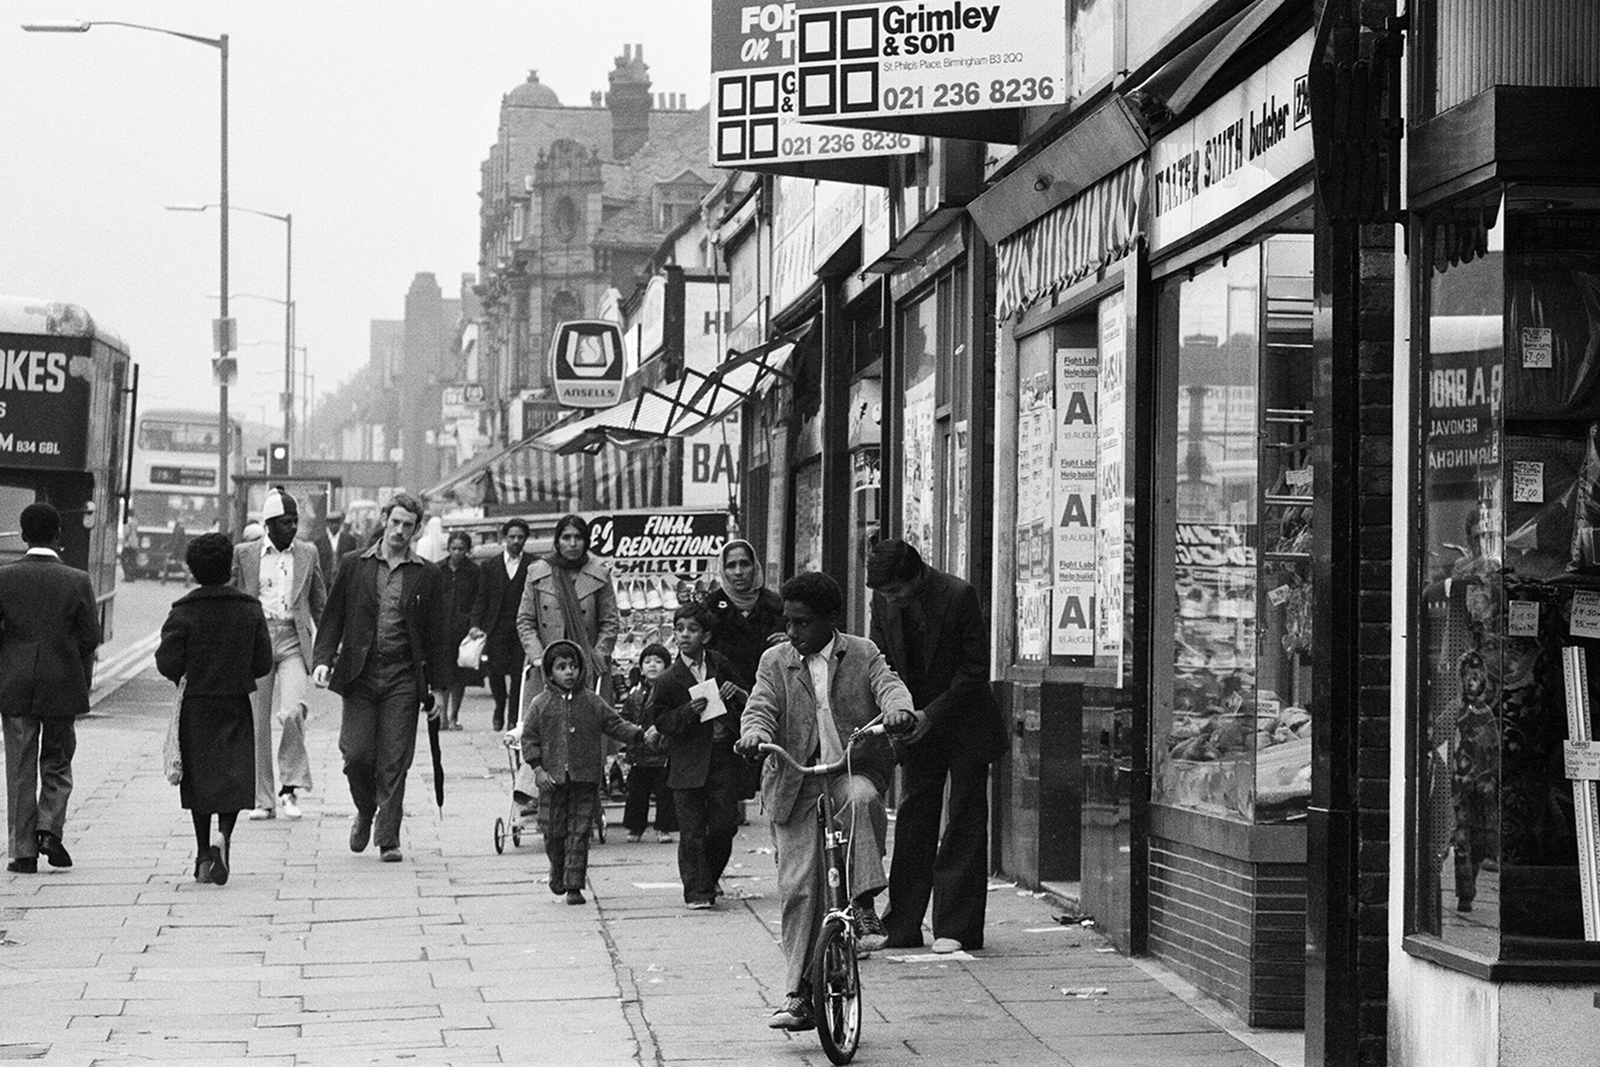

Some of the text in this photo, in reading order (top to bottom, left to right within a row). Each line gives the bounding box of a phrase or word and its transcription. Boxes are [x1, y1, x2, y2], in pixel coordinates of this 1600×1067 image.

[883, 1, 1000, 34] Grimley
[883, 32, 954, 57] & son
[944, 54, 987, 68] Birmingham
[989, 54, 1001, 64] B3
[781, 71, 796, 95] G
[883, 76, 1054, 111] 021 236 8236
[781, 97, 794, 113] &
[782, 132, 911, 156] 021 236 8236
[1204, 118, 1244, 188] SMITH
[1249, 95, 1290, 161] butcher
[1064, 357, 1097, 366] Fight Lab
[1064, 368, 1079, 376] Help
[1064, 382, 1086, 391] VOTE
[16, 440, 36, 453] B34
[692, 443, 742, 484] BA
[1060, 459, 1078, 468] Fight
[1060, 471, 1076, 479] Help
[1060, 484, 1082, 493] VOTE
[644, 515, 694, 535] FINAL
[615, 536, 725, 557] REDUCTIONS
[1059, 560, 1077, 569] Fight
[1059, 573, 1075, 581] Help
[1059, 586, 1081, 594] VOTE
